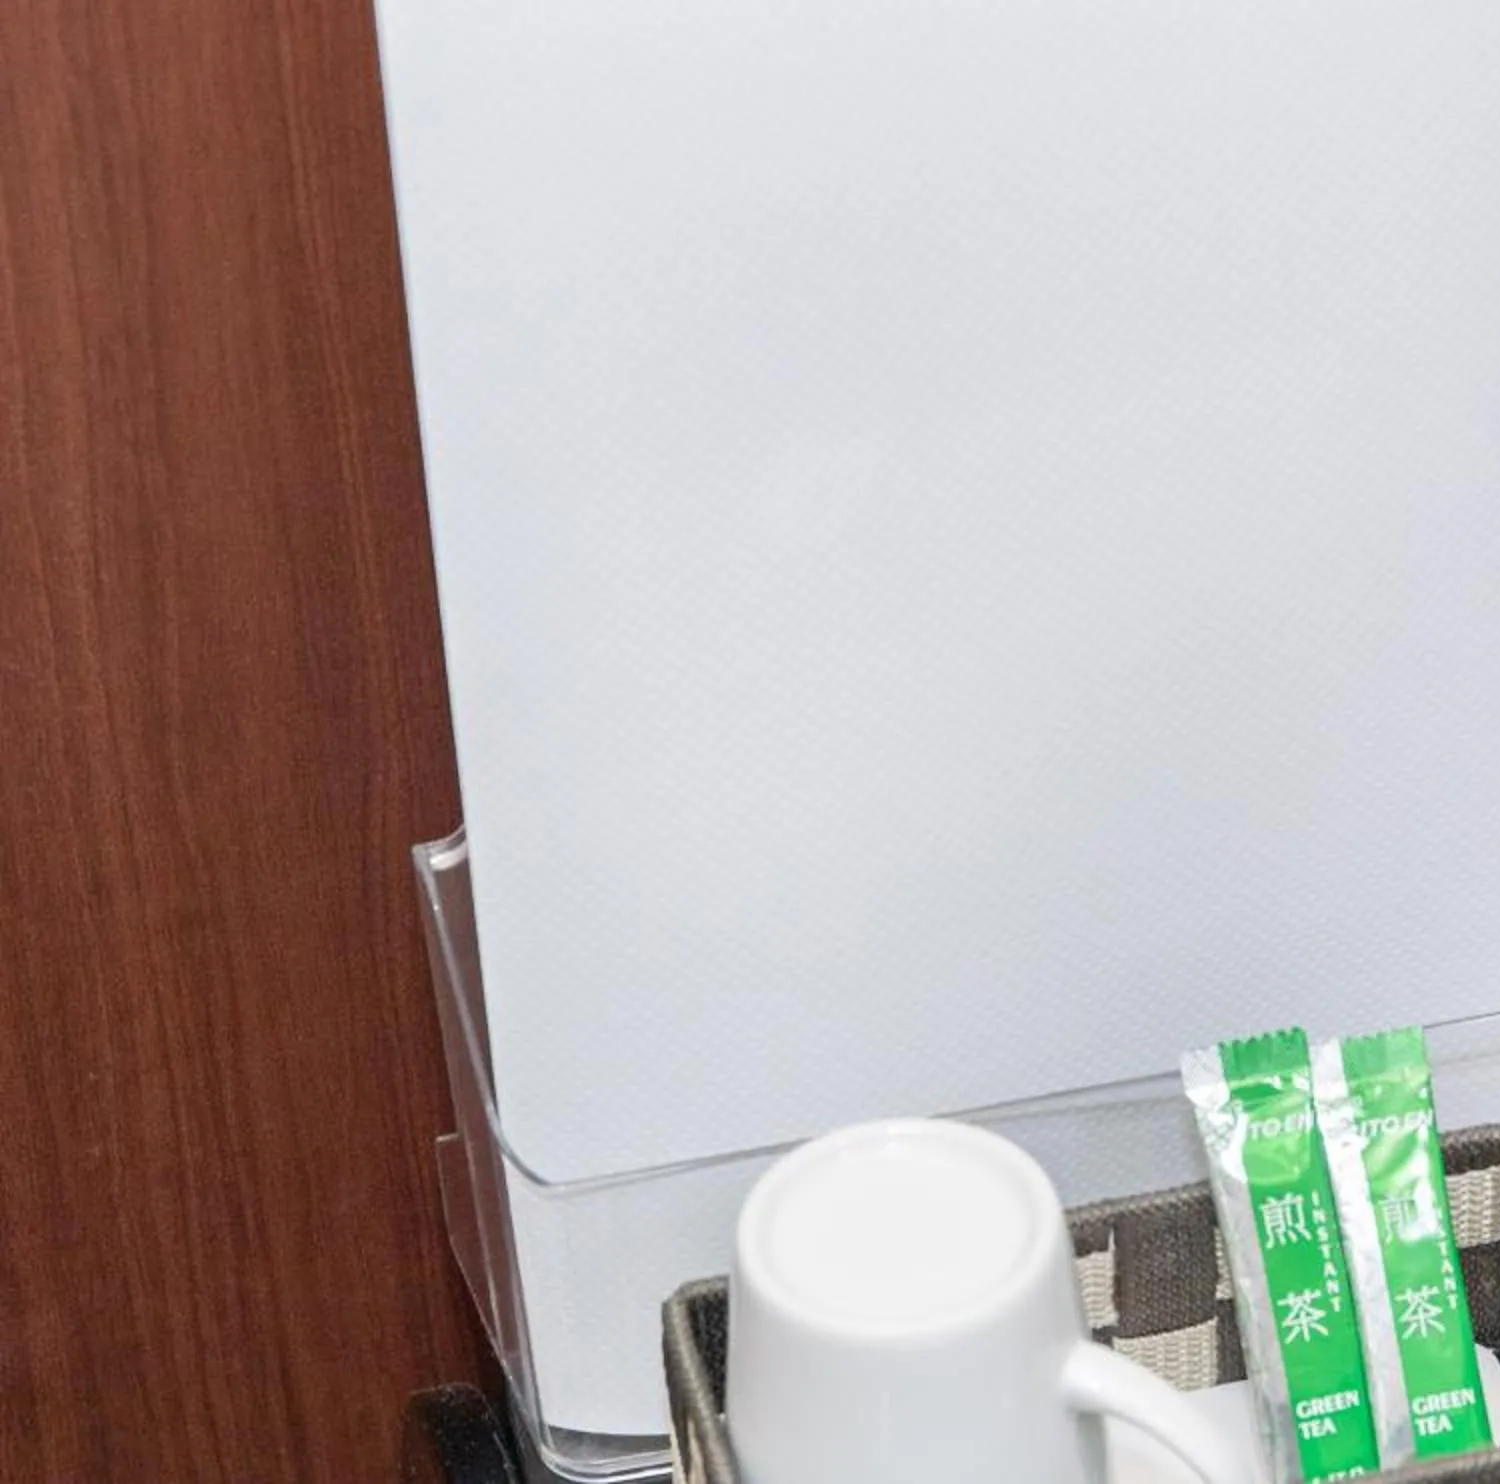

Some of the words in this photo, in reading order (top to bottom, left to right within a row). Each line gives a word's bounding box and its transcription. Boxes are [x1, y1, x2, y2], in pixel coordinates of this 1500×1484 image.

[1311, 1190, 1341, 1313] INSTANT
[1259, 1192, 1329, 1345] 煎茶
[1295, 1389, 1361, 1419] GREEN
[1412, 1387, 1476, 1416] GREEN
[1299, 1416, 1338, 1441] TEA
[1415, 1413, 1453, 1437] TEA
